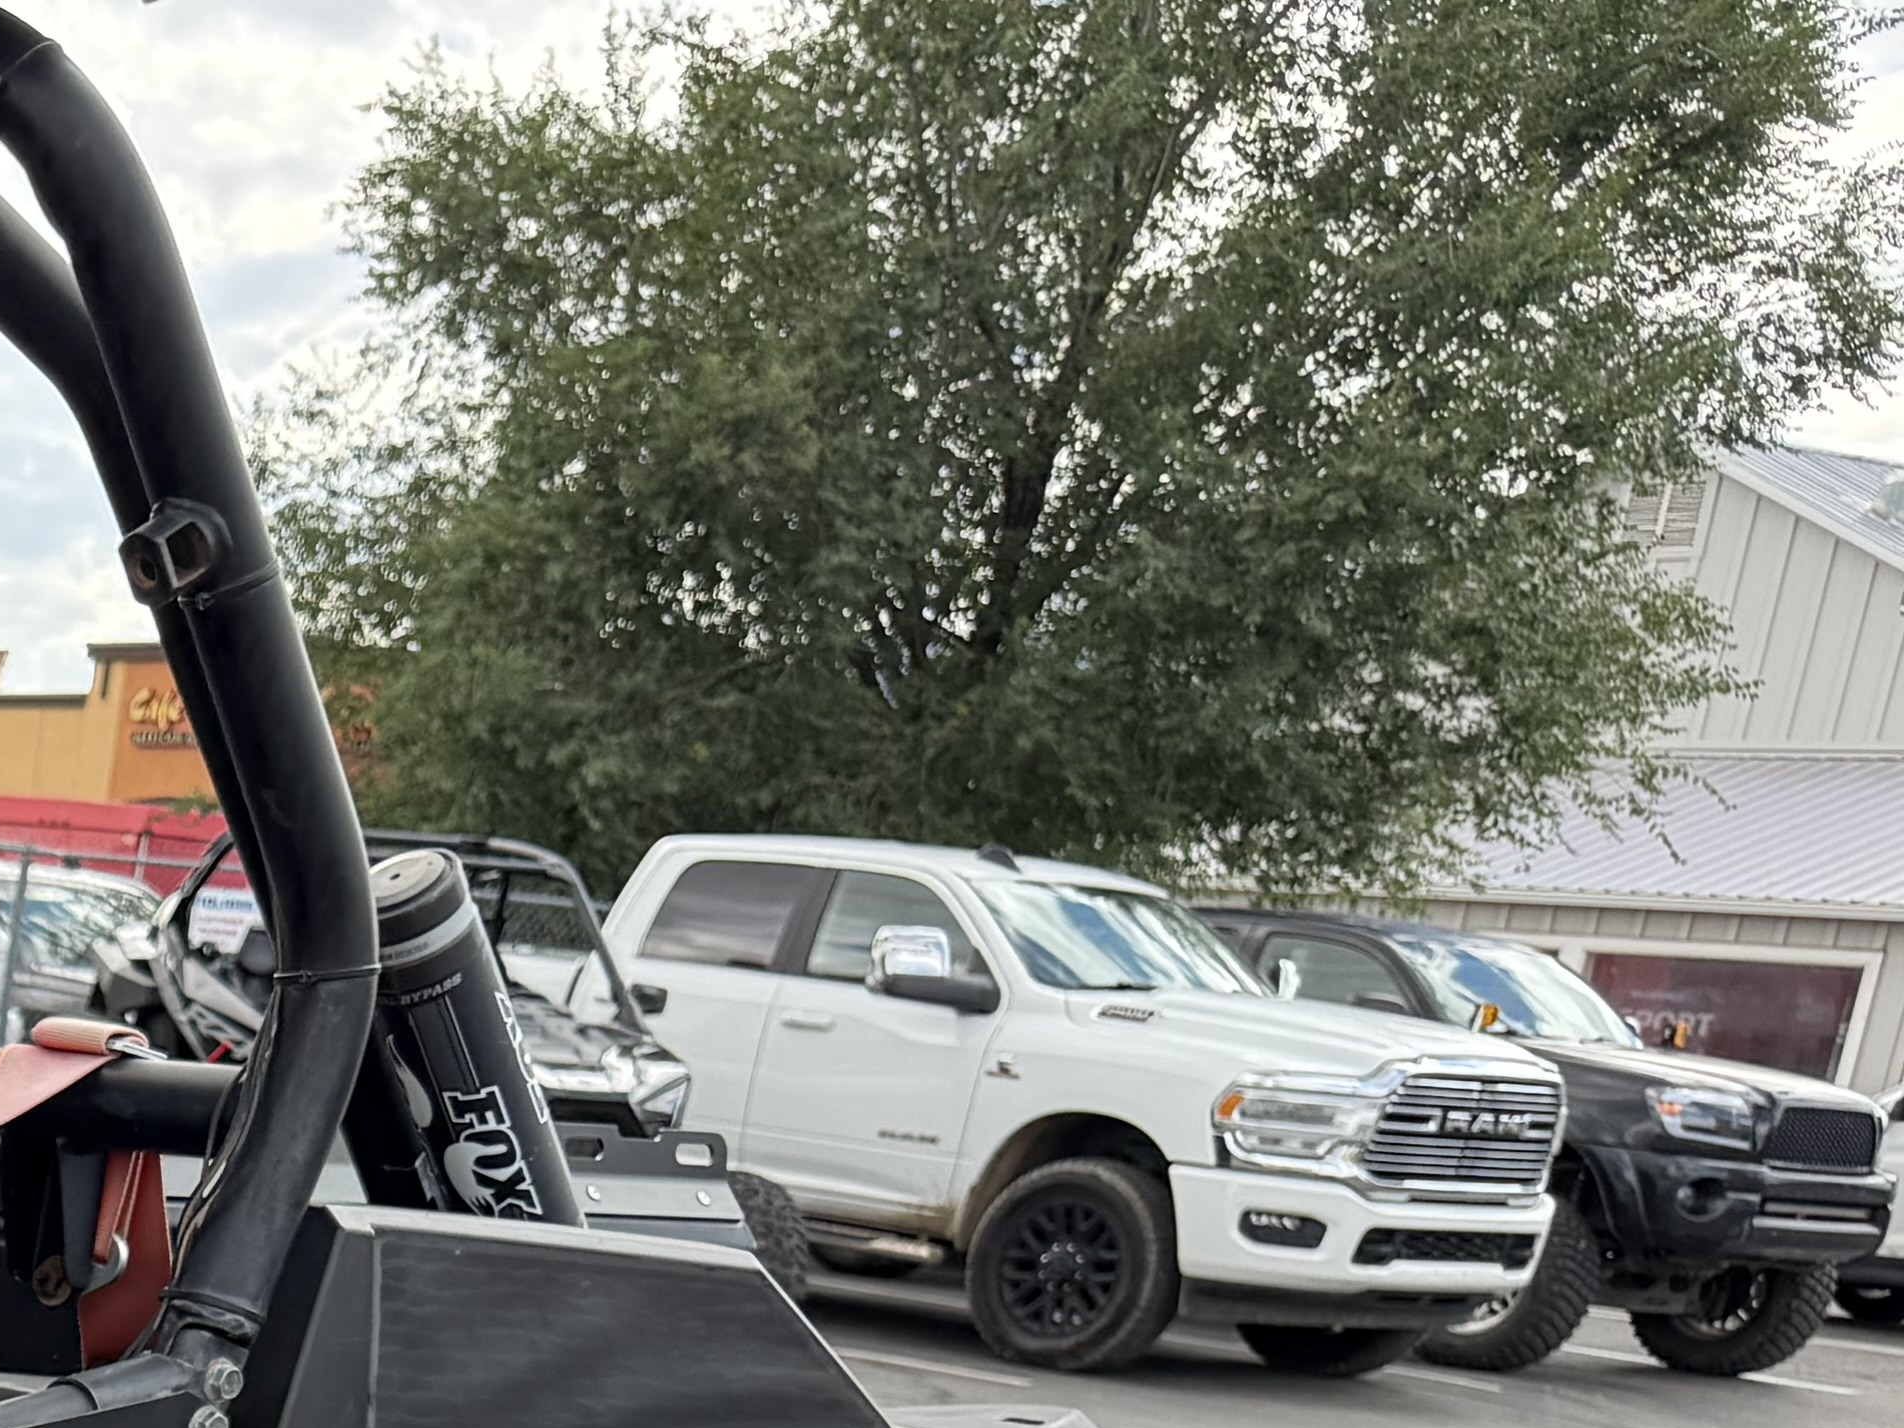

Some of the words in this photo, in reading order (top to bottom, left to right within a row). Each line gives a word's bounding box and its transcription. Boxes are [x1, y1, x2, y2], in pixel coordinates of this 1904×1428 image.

[400, 972, 462, 1006] BYPASS
[1445, 1110, 1524, 1137] RAM
[442, 1085, 543, 1218] FOX
